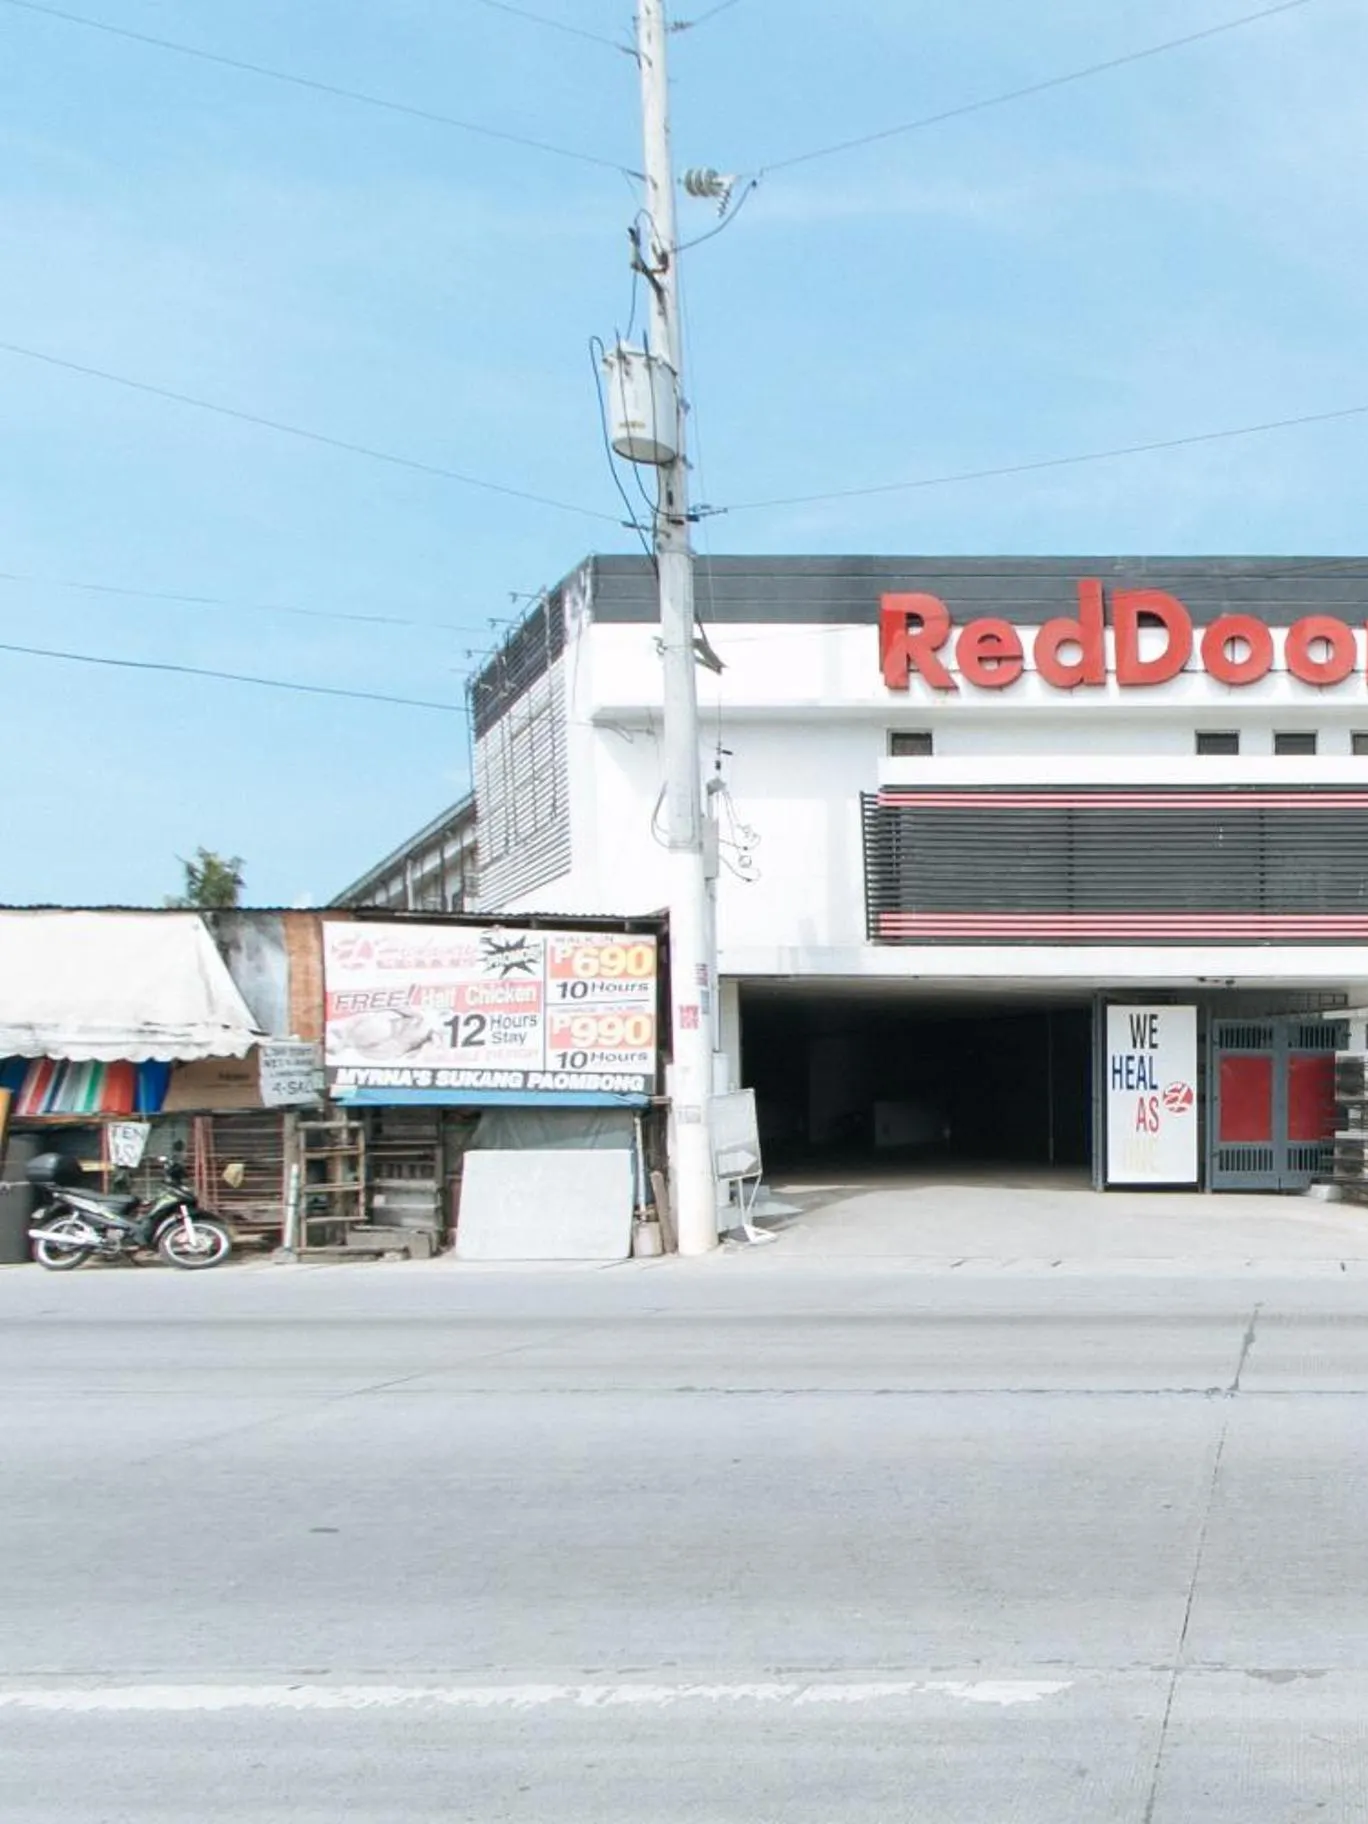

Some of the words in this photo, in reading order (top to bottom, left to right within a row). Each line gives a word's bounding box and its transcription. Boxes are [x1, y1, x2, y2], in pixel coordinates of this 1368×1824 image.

[334, 984, 415, 1011] FREE!
[464, 983, 536, 1006] Chicken
[556, 981, 588, 999] 10
[591, 981, 649, 993] Hours
[444, 1014, 487, 1049] 12
[490, 1013, 538, 1030] Hours
[491, 1031, 528, 1046] Stay
[1130, 1014, 1158, 1049] WE
[556, 1051, 588, 1069] 10
[590, 1050, 648, 1063] Hours
[1112, 1055, 1158, 1090] HEAL
[336, 1068, 431, 1087] MYRNA'S
[436, 1071, 522, 1089] SUKANG
[1135, 1097, 1159, 1133] AS
